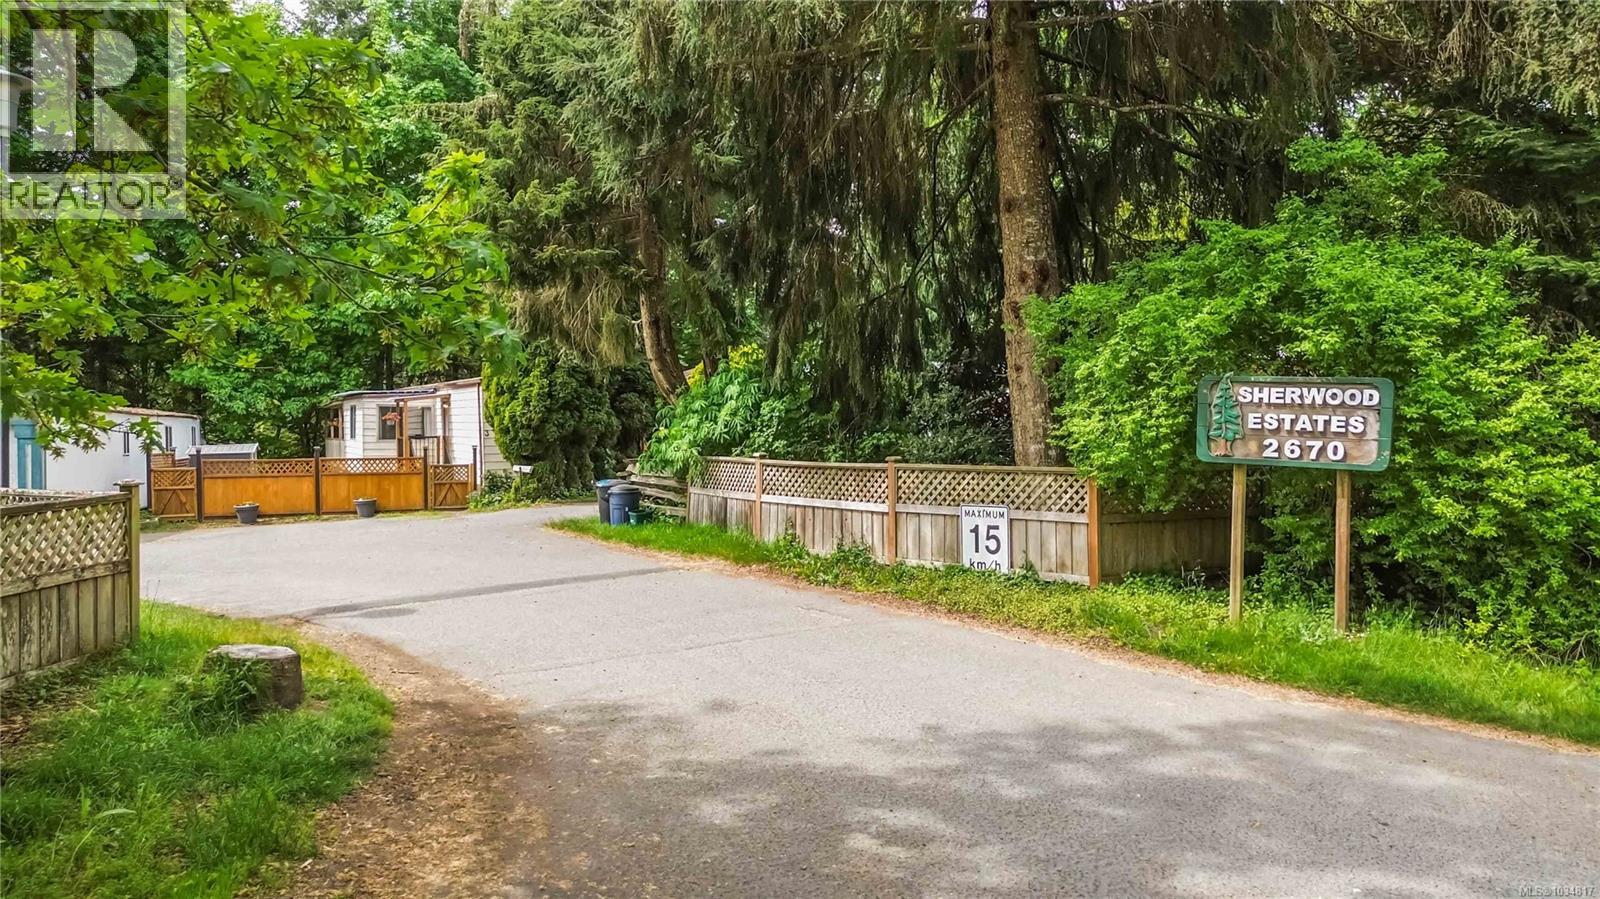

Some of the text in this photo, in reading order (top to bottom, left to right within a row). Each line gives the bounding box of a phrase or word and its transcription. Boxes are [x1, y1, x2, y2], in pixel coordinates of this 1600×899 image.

[1238, 386, 1380, 406] SHERWOOD
[1248, 413, 1364, 433] ESTATES
[1262, 438, 1344, 460] 2670
[964, 509, 1005, 519] MAXIMUM
[969, 524, 1001, 555] 15
[969, 558, 1001, 570] km/h
